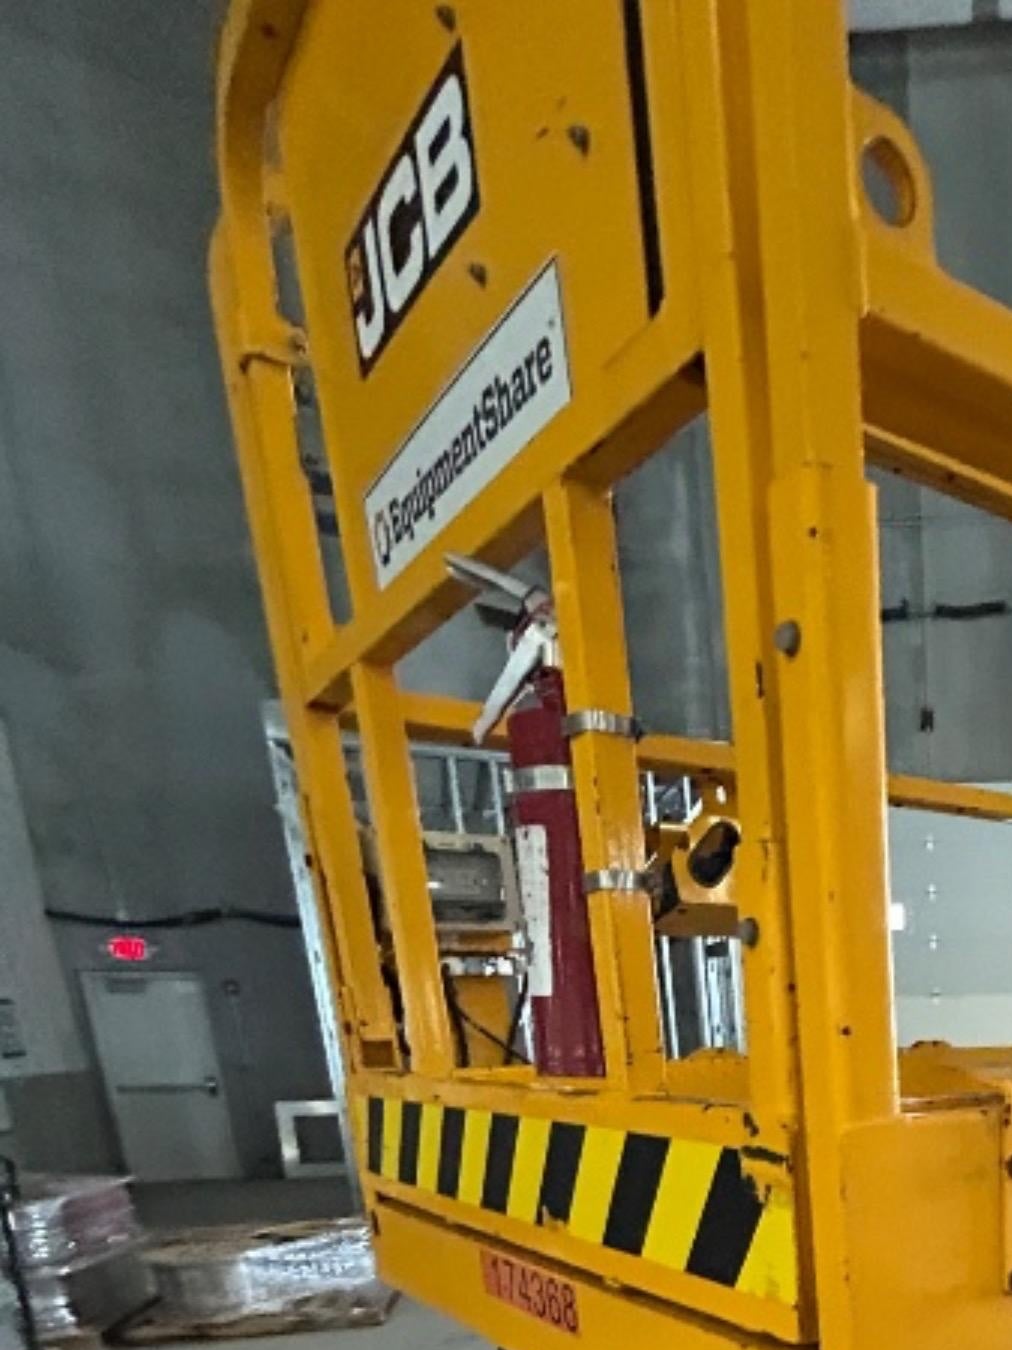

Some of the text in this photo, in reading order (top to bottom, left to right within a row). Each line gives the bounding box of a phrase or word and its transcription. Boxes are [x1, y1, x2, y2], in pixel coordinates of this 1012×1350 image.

[356, 73, 473, 359] JCB
[389, 336, 553, 543] EquipmentShare
[490, 1257, 579, 1334] 174368
